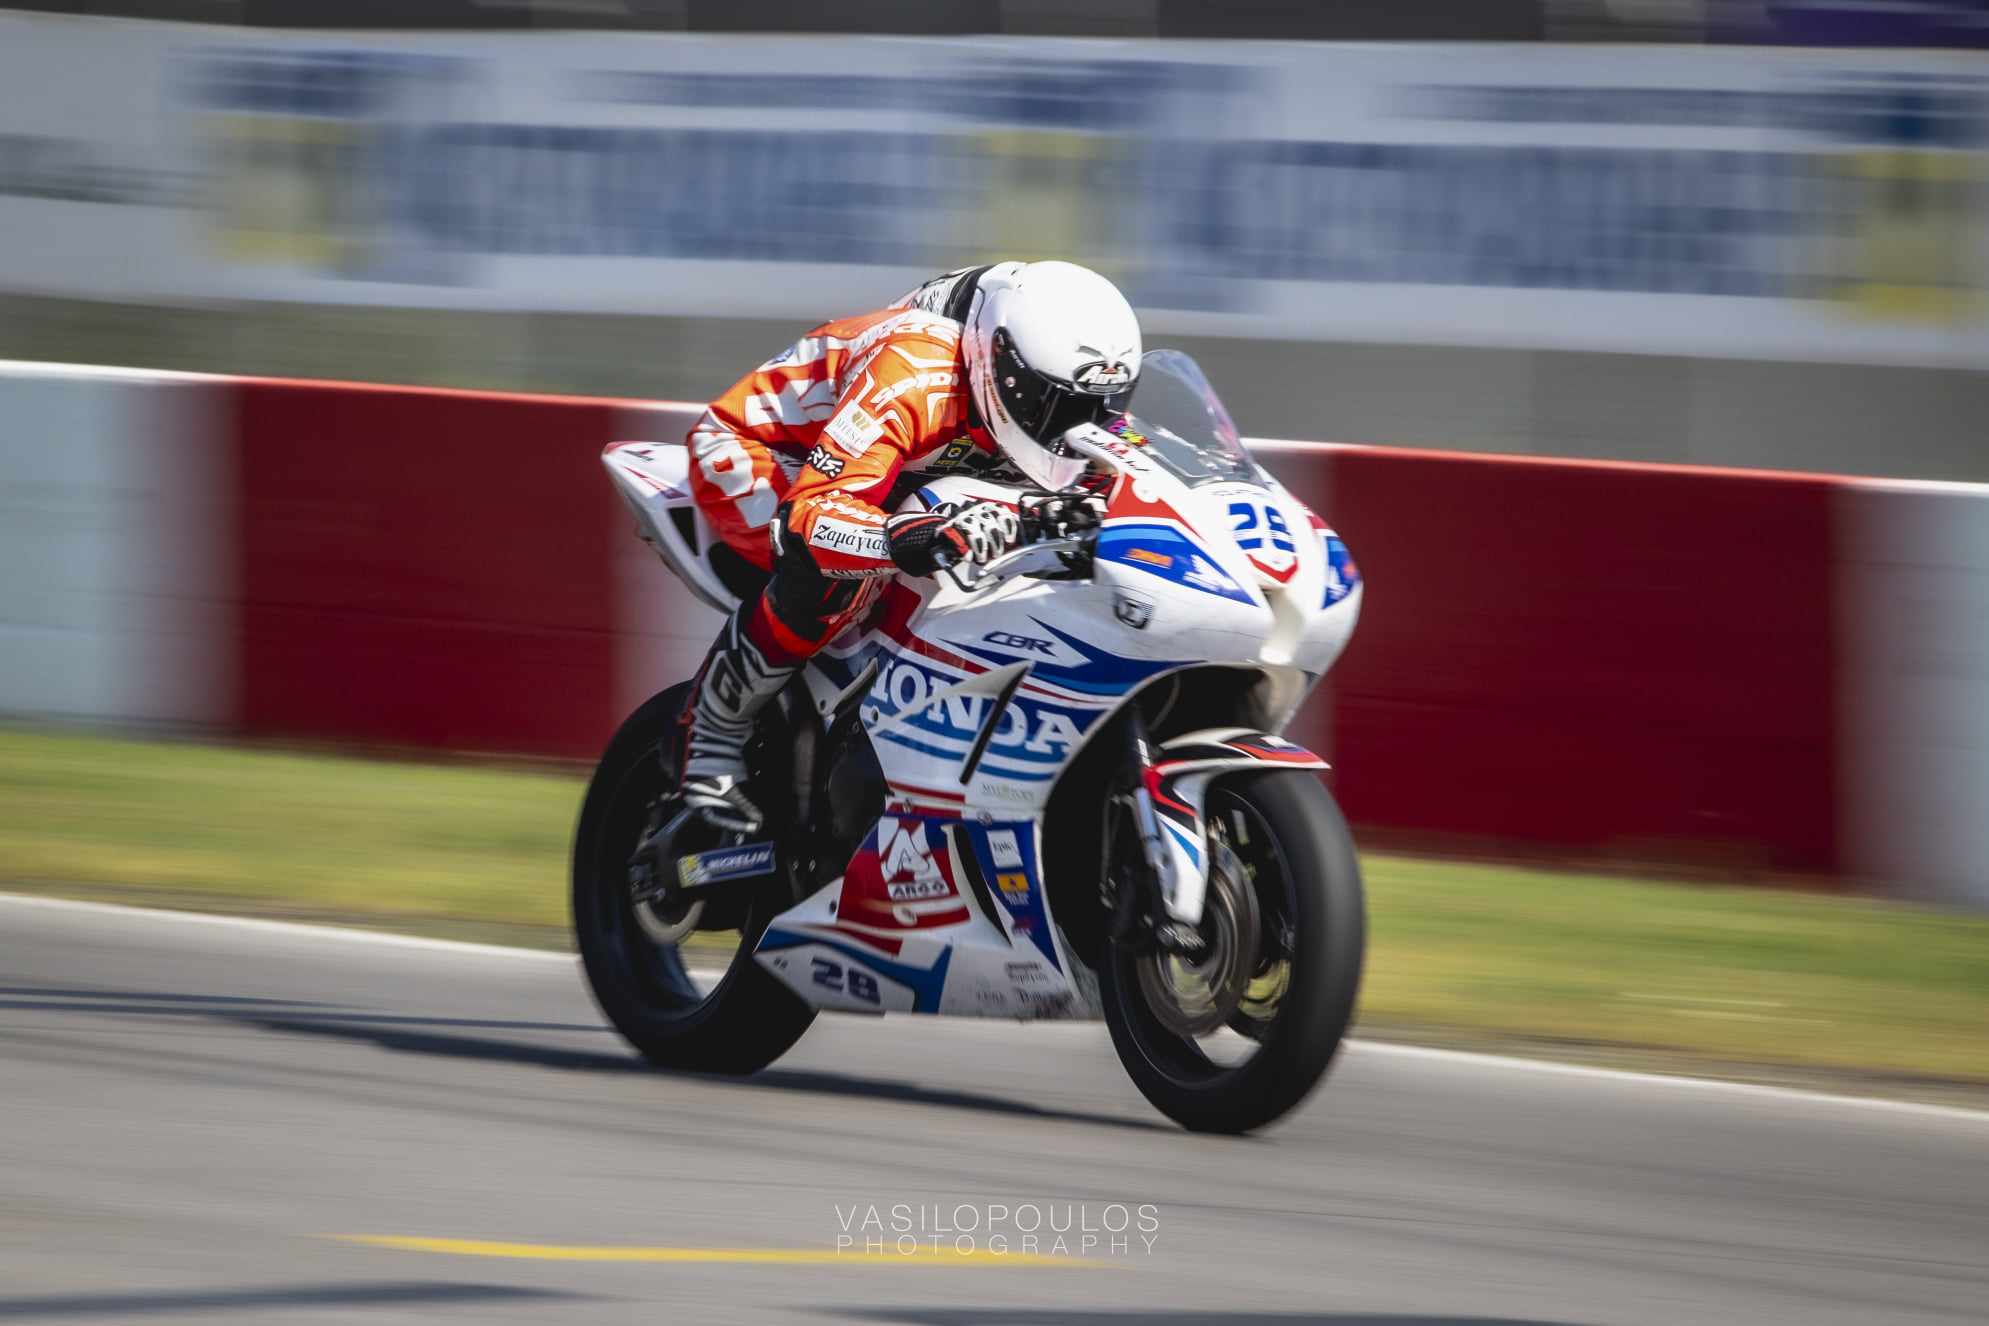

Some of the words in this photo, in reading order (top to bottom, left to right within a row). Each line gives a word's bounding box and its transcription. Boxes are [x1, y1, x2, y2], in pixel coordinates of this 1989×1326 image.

[1229, 502, 1296, 553] 28
[982, 631, 1058, 658] CBR
[811, 957, 880, 1006] 28
